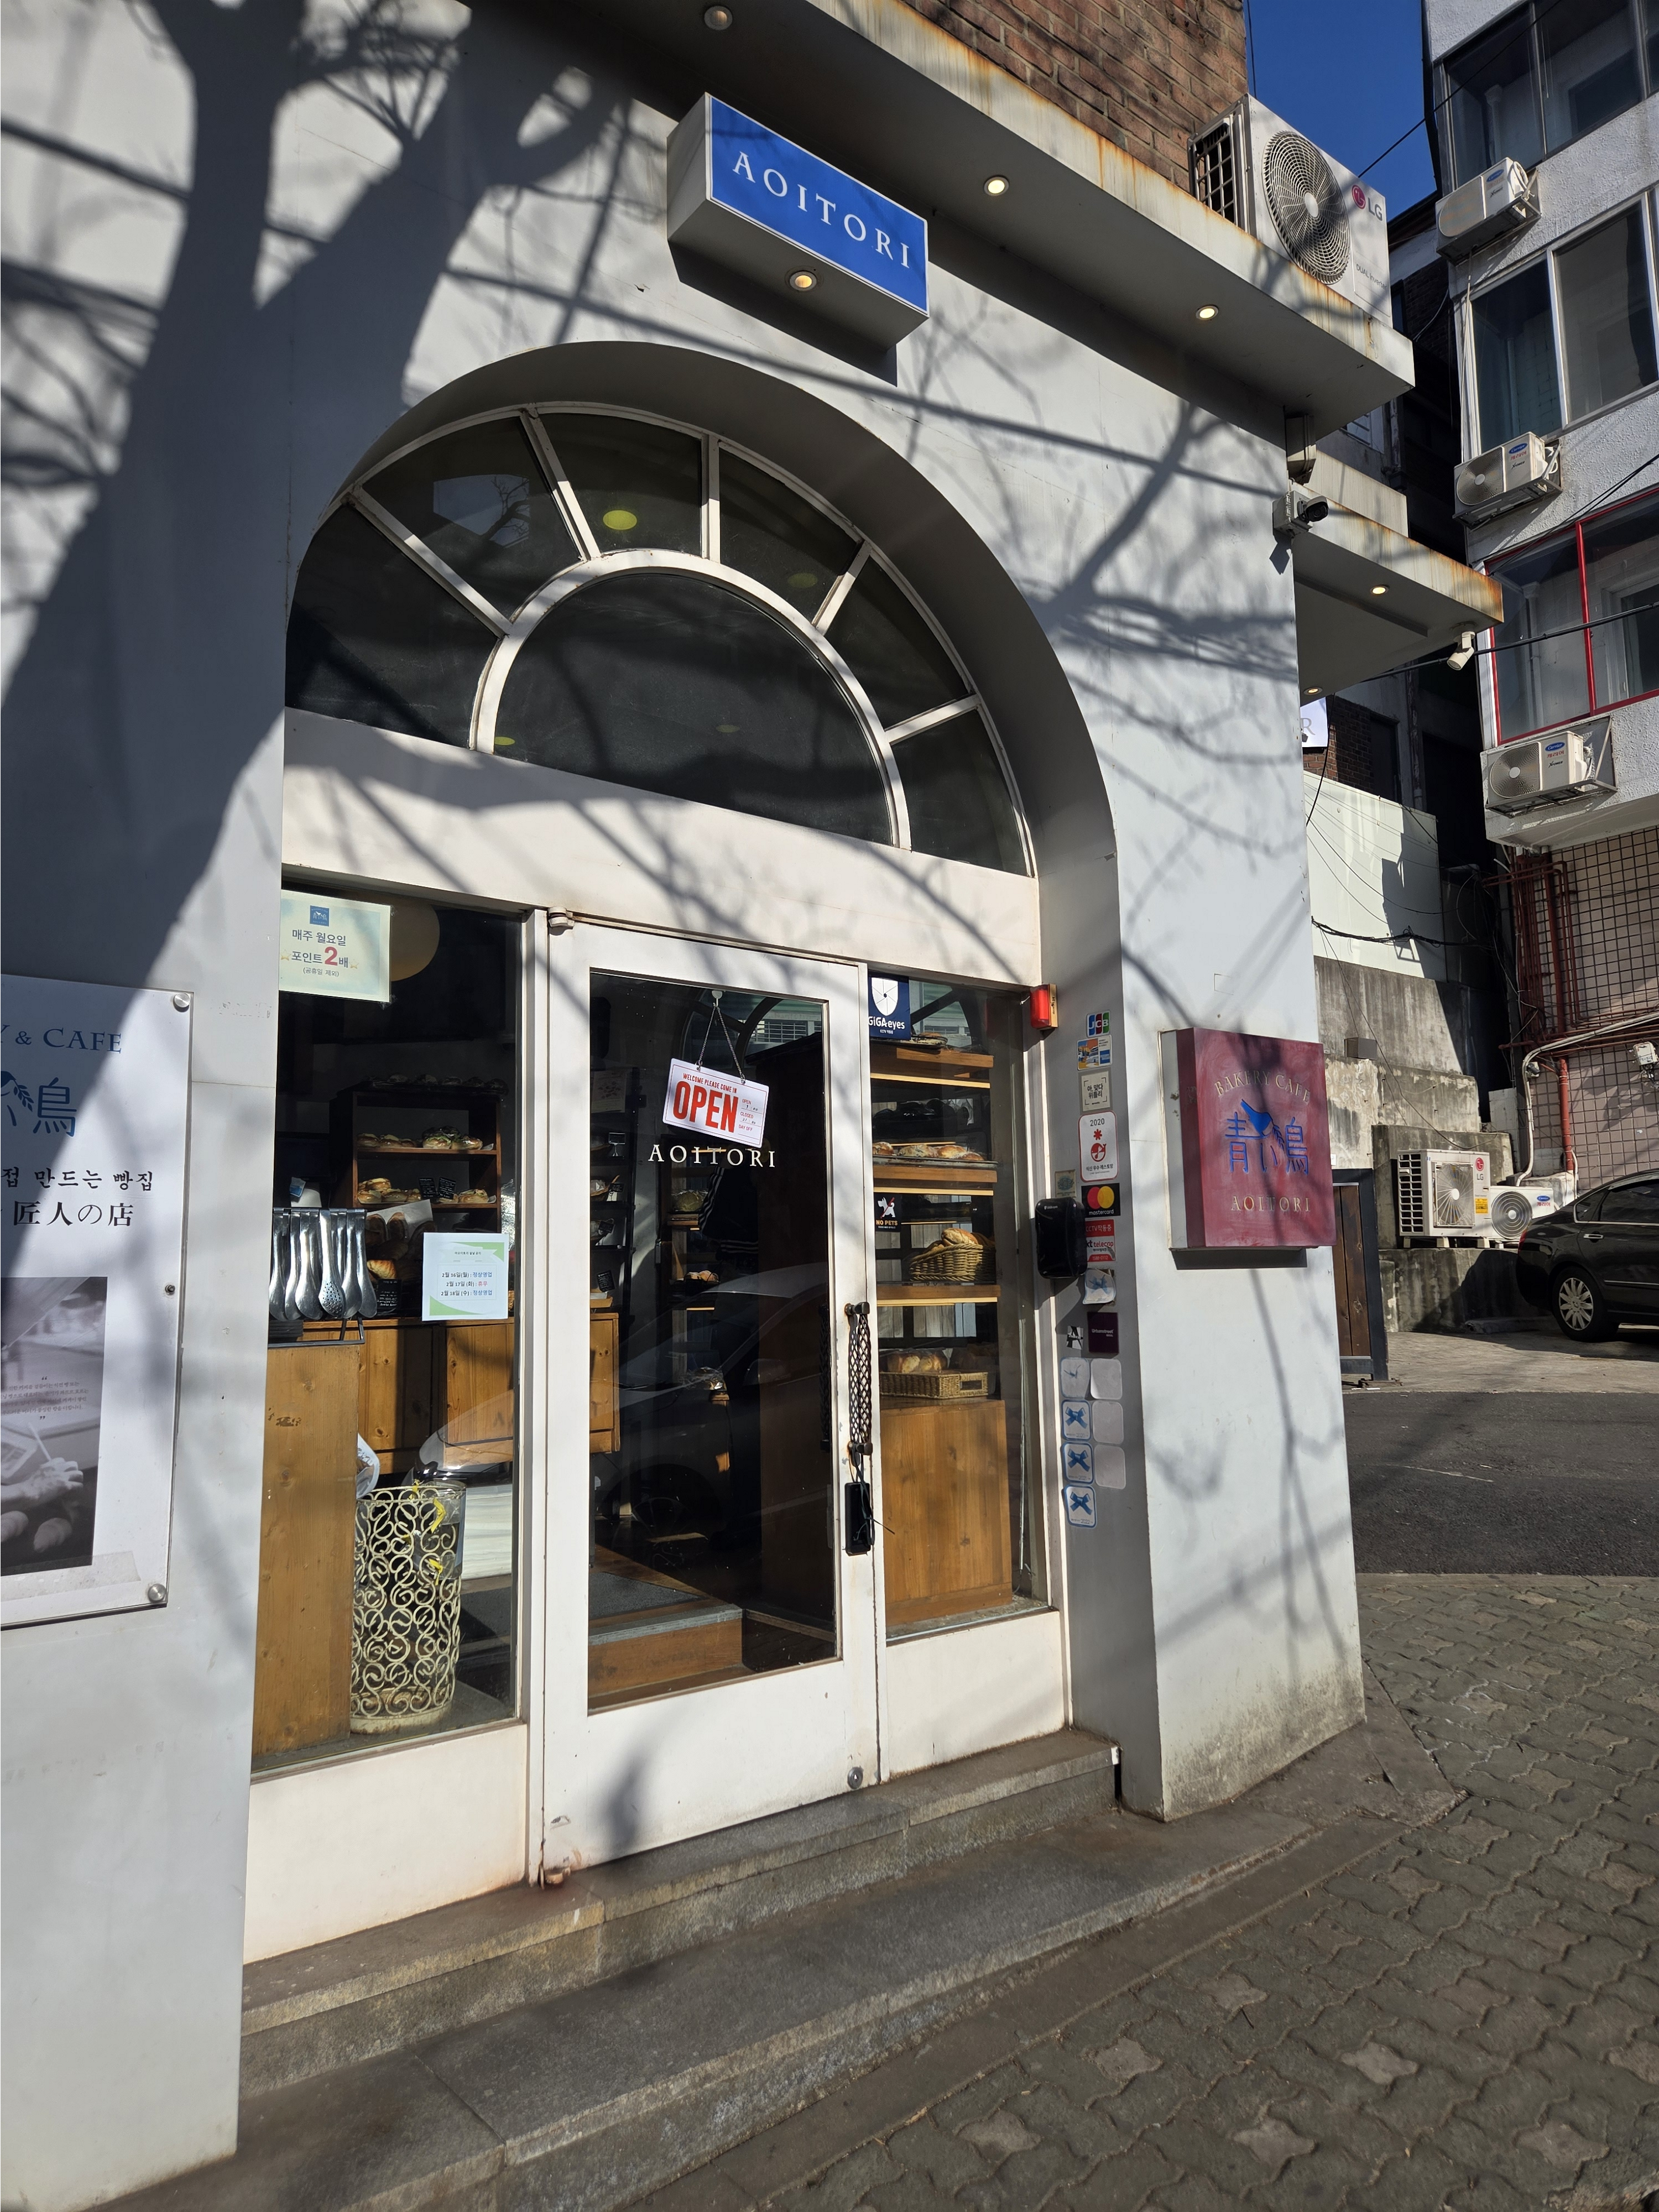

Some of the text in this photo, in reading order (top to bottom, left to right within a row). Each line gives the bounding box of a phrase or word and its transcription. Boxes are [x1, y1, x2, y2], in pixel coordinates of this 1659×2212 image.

[733, 152, 910, 268] AOITORI
[1368, 197, 1383, 221] LG
[1357, 264, 1387, 290] DUAL Inverter
[292, 929, 346, 946] 매주 월요일
[291, 951, 322, 964] 포인트
[303, 967, 340, 977] (공휴일 제외)
[1088, 1019, 1109, 1029] JCB
[15, 1031, 32, 1045] &
[43, 1027, 122, 1053] CAFE
[683, 1073, 704, 1084] WELCOME
[705, 1079, 720, 1088] PLEASE
[721, 1084, 732, 1093] COME
[1214, 1070, 1311, 1104] BAKERY CAFE
[673, 1081, 739, 1133] OPEN
[1090, 1118, 1105, 1126] 2020
[1225, 1112, 1310, 1175] 青い鳥
[648, 1144, 775, 1167] AOITORI
[34, 1167, 102, 1189] 만드는
[113, 1170, 154, 1191] 빵집
[1231, 1195, 1311, 1212] AOITORI
